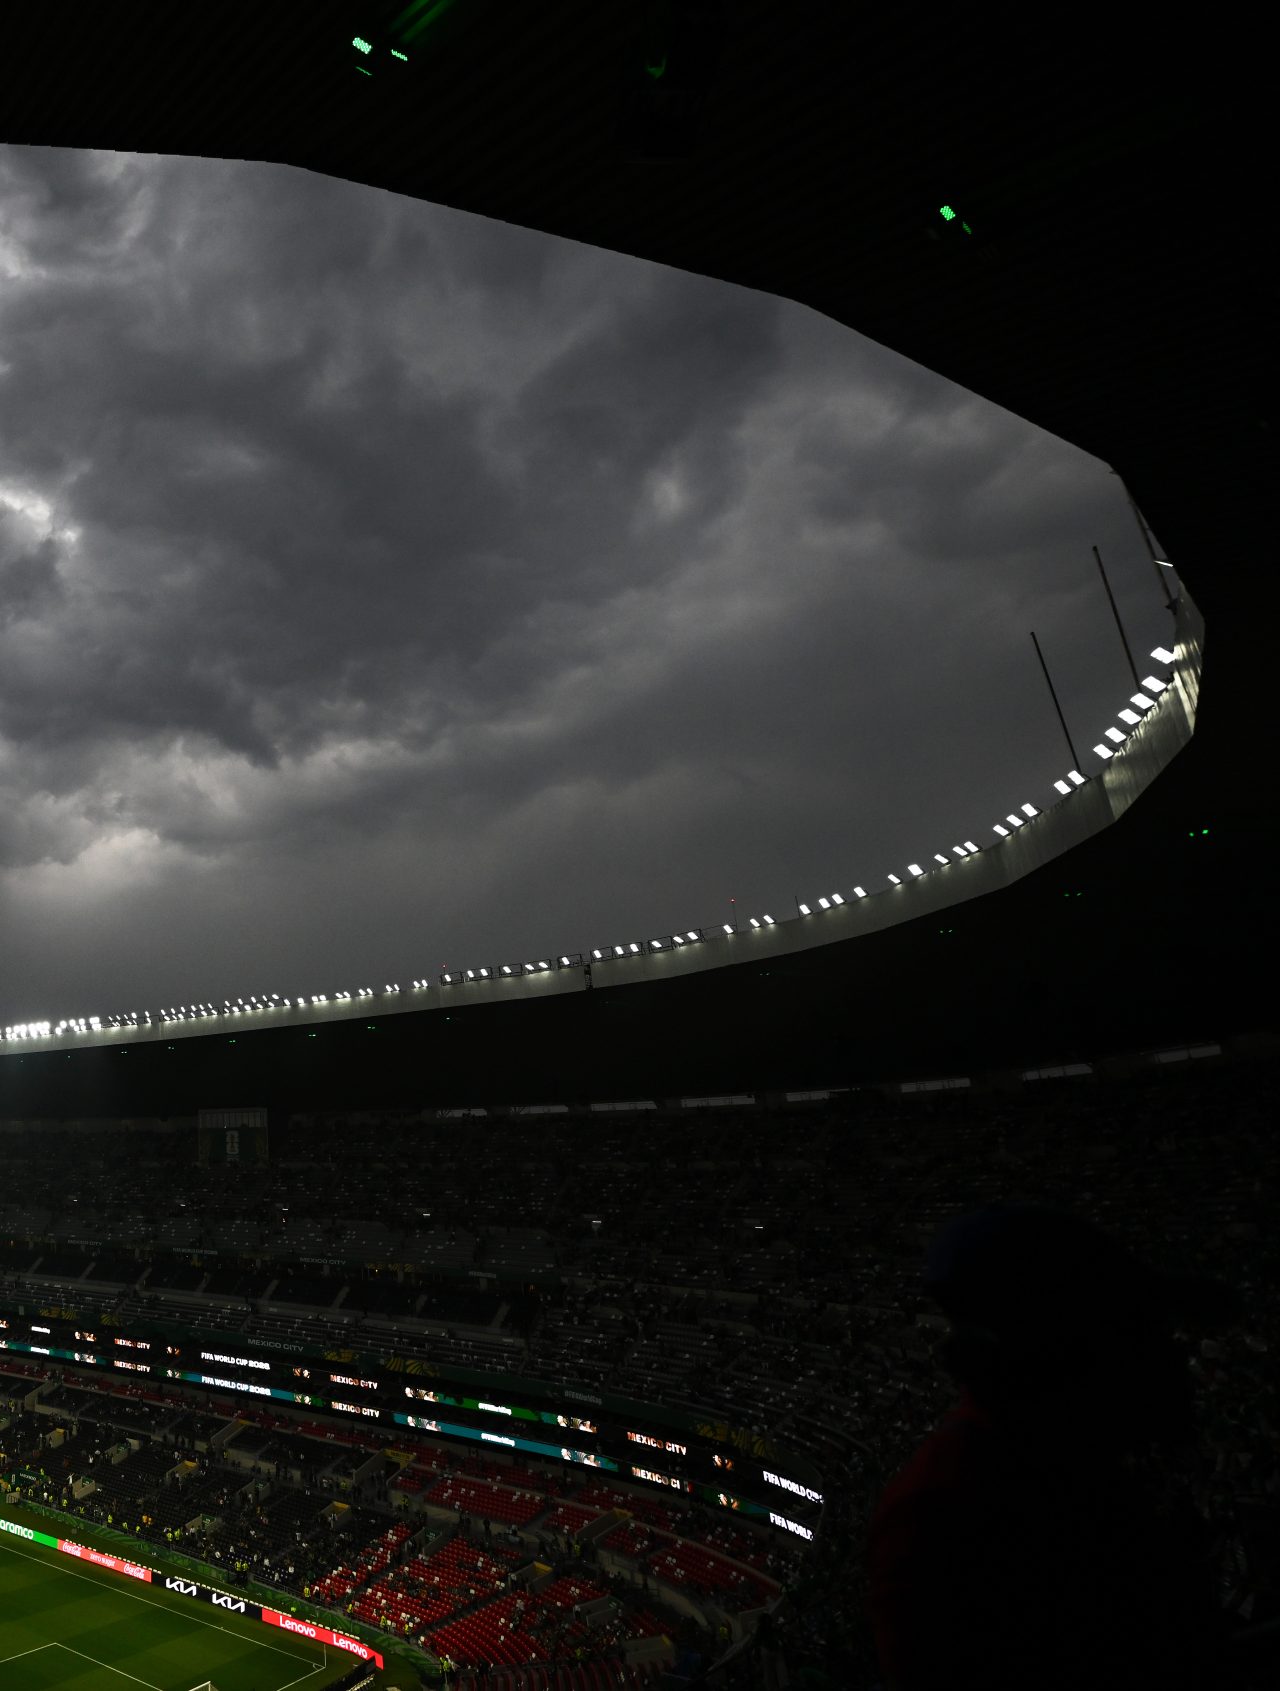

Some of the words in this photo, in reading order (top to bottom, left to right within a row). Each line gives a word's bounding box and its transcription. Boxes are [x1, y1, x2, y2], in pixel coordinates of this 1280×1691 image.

[248, 1338, 282, 1349] MEXICO
[282, 1343, 304, 1353] CITY
[136, 1364, 151, 1373] CITY
[201, 1352, 214, 1361] FIFA
[214, 1354, 235, 1365] WORLD
[235, 1357, 248, 1367] CUP
[201, 1376, 214, 1385] FIFA
[214, 1378, 236, 1389] WORLD
[236, 1381, 249, 1391] CUP
[330, 1374, 359, 1386] MEXICO
[331, 1401, 360, 1414] MEXICO
[361, 1407, 380, 1418] CITY
[627, 1431, 664, 1449] MEXICO
[665, 1440, 687, 1455] CITY
[631, 1466, 669, 1486] MEXICO
[762, 1470, 781, 1487] FIFA
[779, 1477, 807, 1498] WORLD
[0, 1519, 34, 1540] aramco
[769, 1512, 788, 1529] FIFA
[166, 1577, 197, 1597] KIA
[212, 1592, 245, 1613] KIA
[279, 1615, 316, 1637] Lenovo
[333, 1632, 368, 1659] Lenovo
